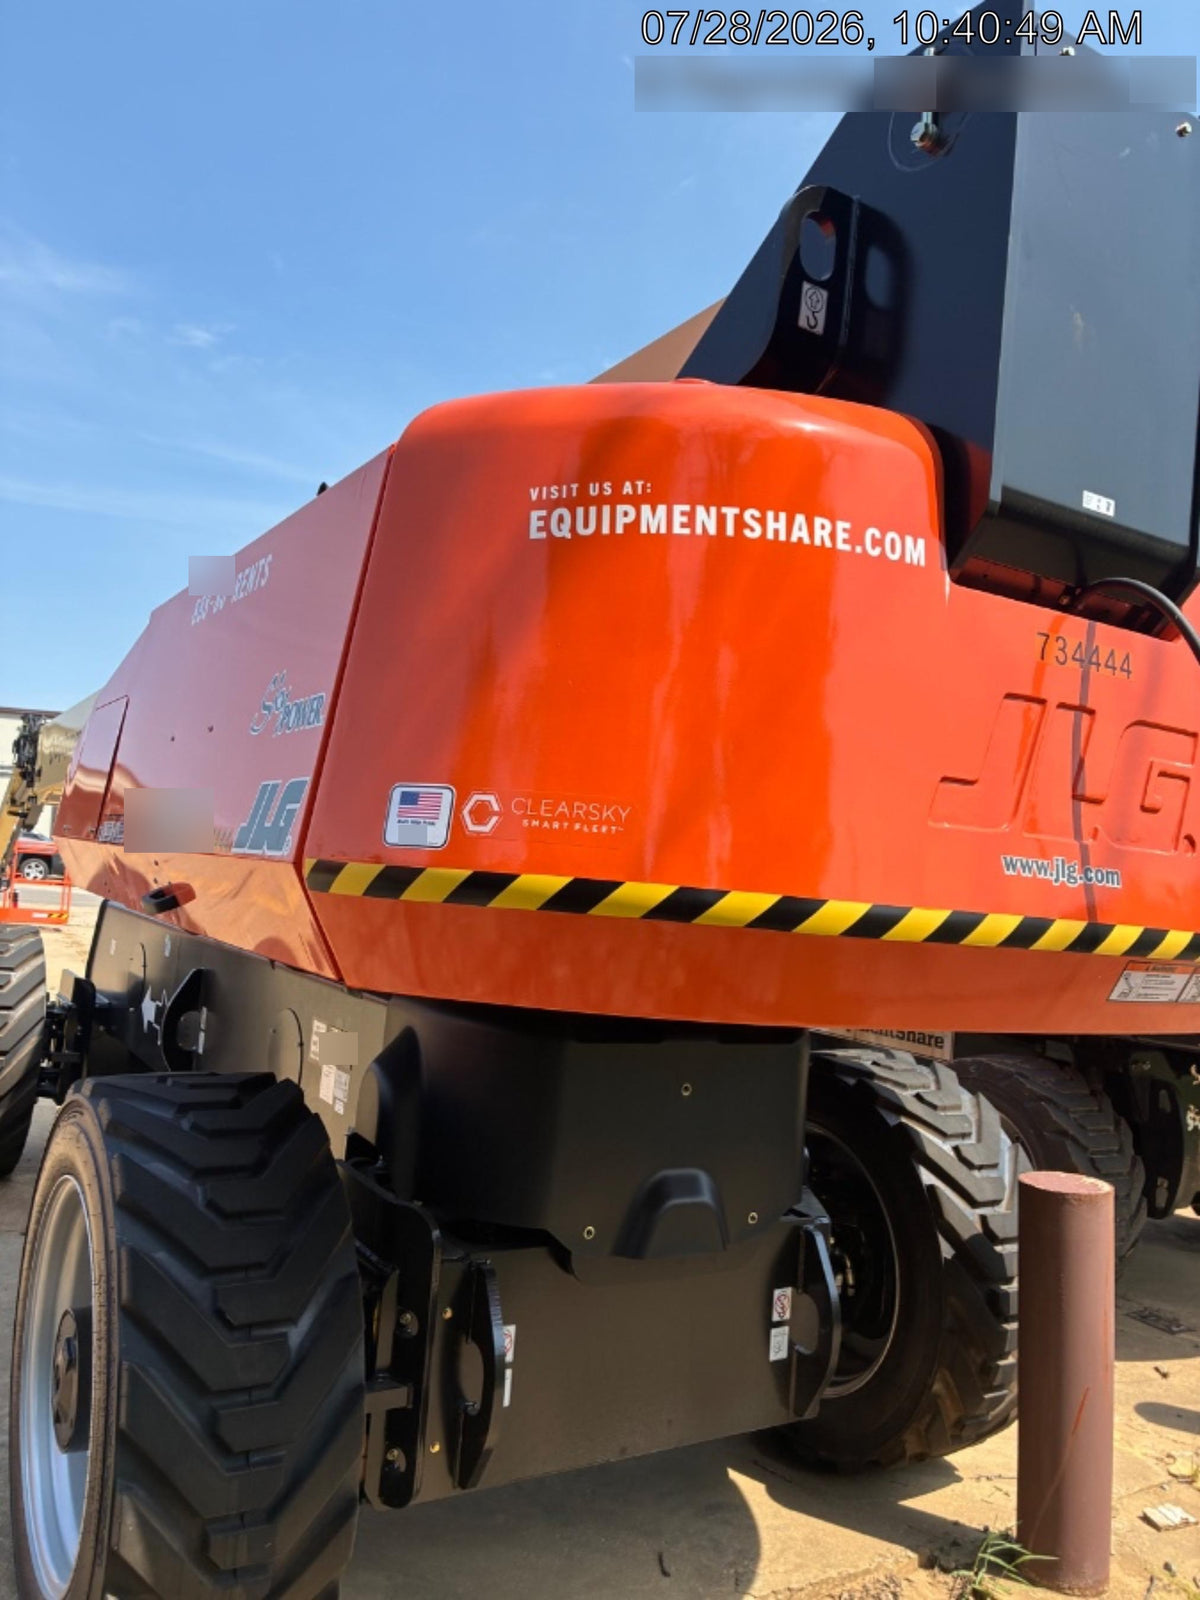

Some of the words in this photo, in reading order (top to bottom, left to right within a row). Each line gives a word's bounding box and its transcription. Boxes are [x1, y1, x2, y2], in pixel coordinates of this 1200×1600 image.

[529, 484, 579, 501] VISIT
[589, 482, 612, 497] US
[622, 480, 652, 496] AT:
[529, 504, 926, 568] EQUIPMENTSHARE.COM
[1037, 631, 1132, 680] 734444
[928, 692, 1199, 856] JLG
[230, 776, 311, 856] JLG
[511, 797, 632, 823] CLEARSKY
[522, 819, 569, 831] SMART
[1000, 855, 1122, 889] www.jlg.com
